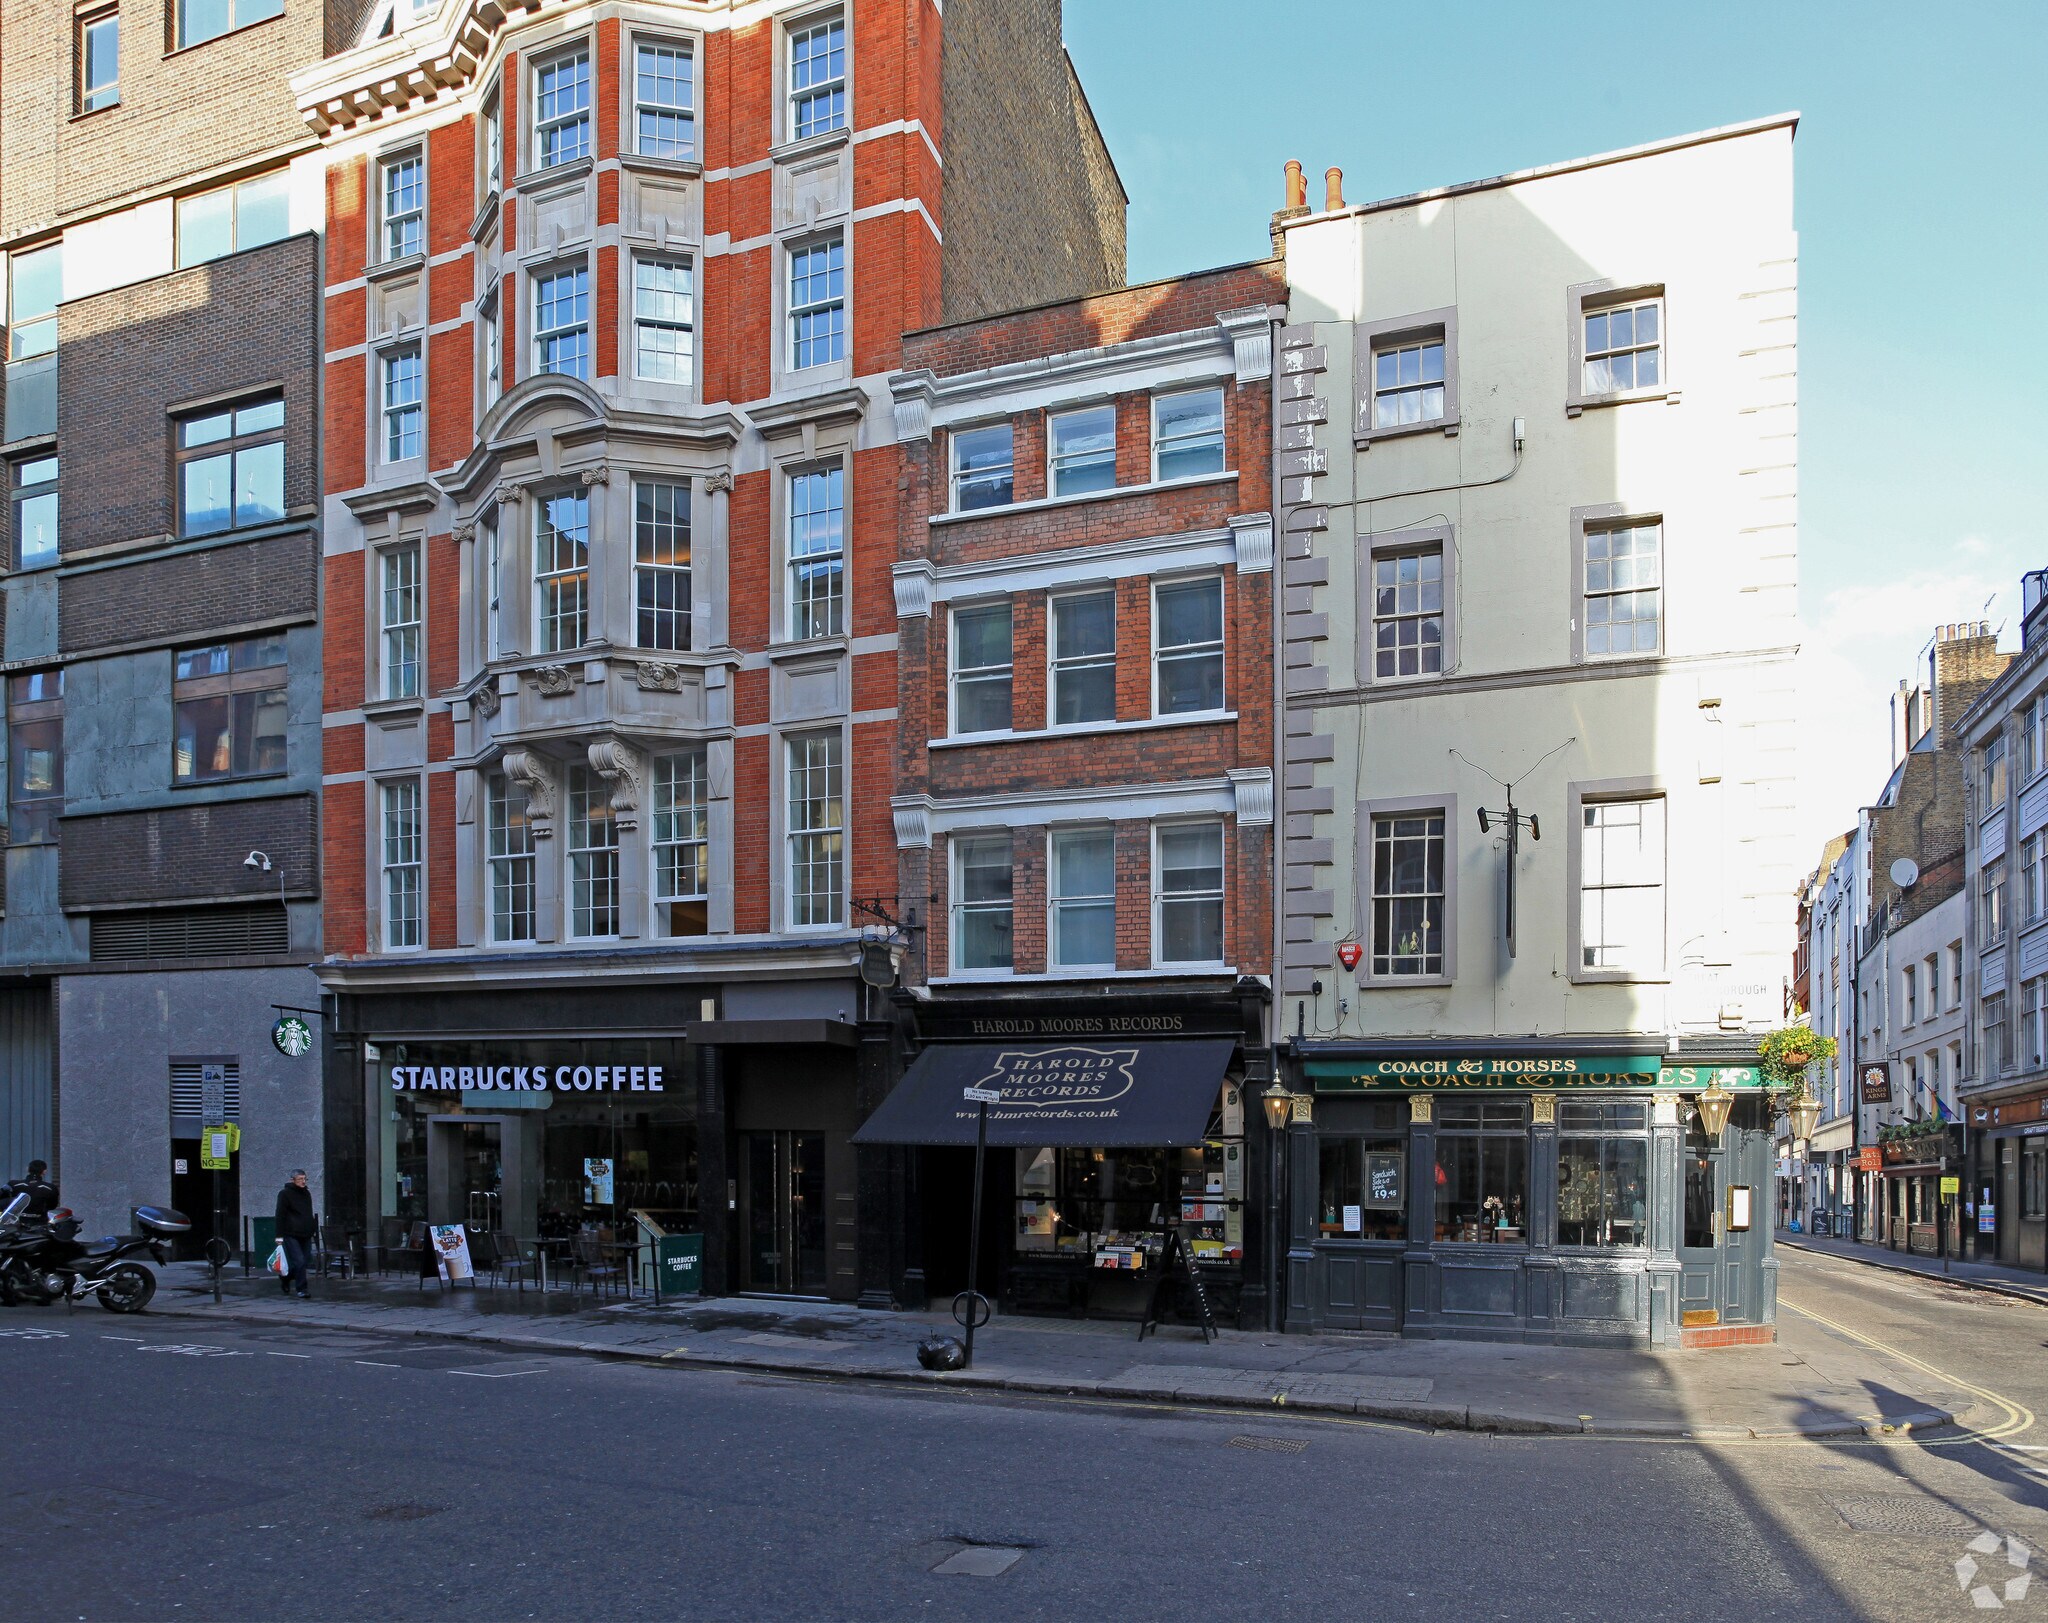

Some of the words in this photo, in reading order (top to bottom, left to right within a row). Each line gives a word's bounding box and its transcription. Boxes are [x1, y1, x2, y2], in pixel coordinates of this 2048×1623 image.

[972, 1019, 1035, 1033] HAROLD
[1040, 1018, 1104, 1033] MOORES
[1109, 1016, 1183, 1032] RECORDS
[1012, 1057, 1115, 1070] HAROLD
[1378, 1061, 1448, 1074] COACH
[1456, 1059, 1483, 1074] &
[1491, 1058, 1577, 1073] HORSES
[391, 1066, 548, 1091] STARBUCKS
[555, 1066, 664, 1092] COFFEE
[1004, 1071, 1108, 1084] MOORES
[1565, 1067, 1697, 1086] HORSES
[1000, 1085, 1102, 1098] RECORDS
[1865, 1086, 1887, 1094] KINGS
[1860, 1151, 1881, 1159] Kati
[202, 1159, 214, 1168] NO
[1861, 1159, 1881, 1167] Roll
[1372, 1168, 1396, 1178] Sandwich
[667, 1255, 698, 1265] STARBUCKS
[673, 1262, 692, 1271] COFFEE
